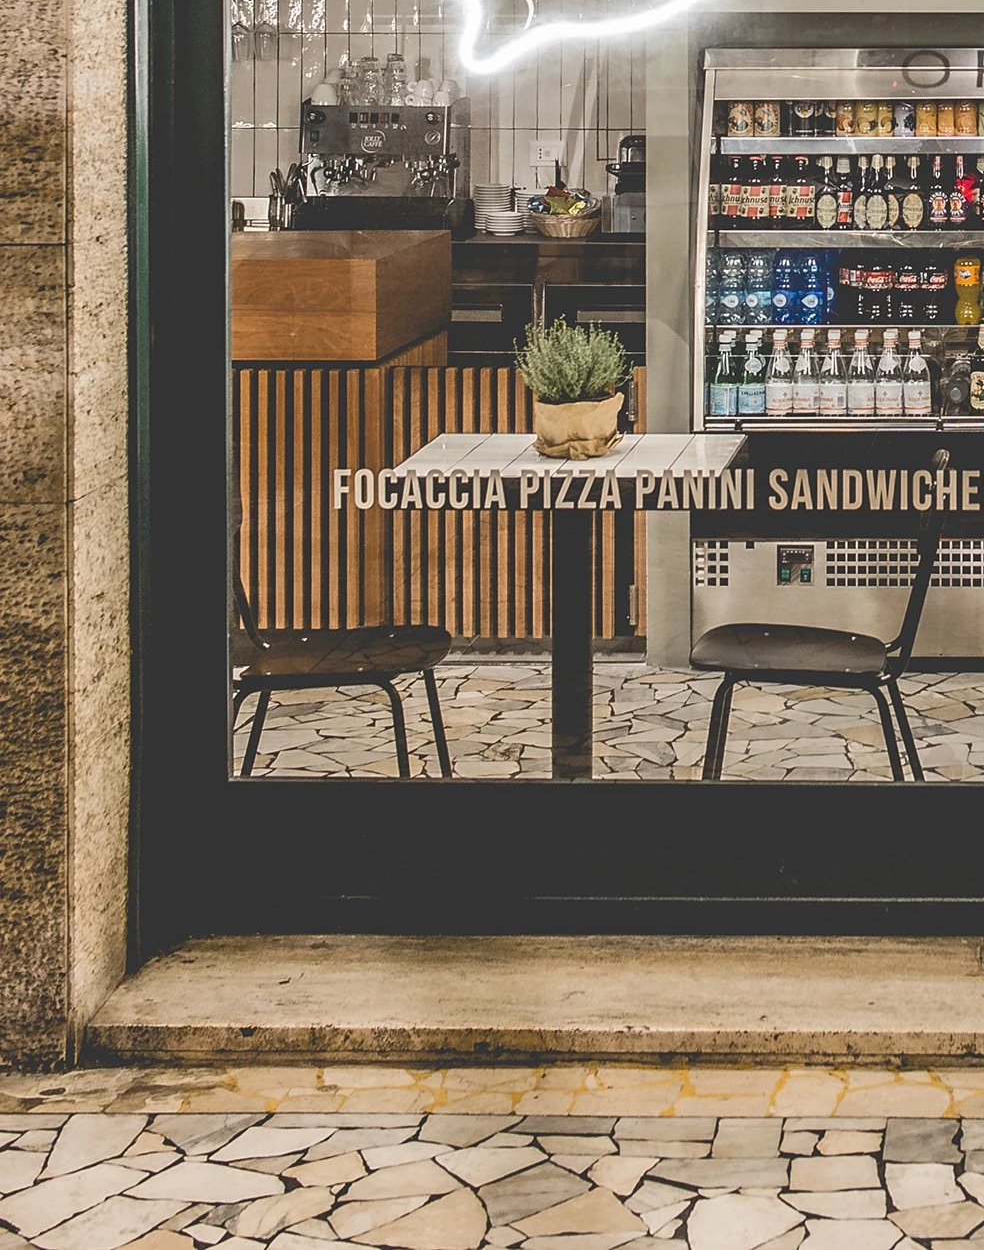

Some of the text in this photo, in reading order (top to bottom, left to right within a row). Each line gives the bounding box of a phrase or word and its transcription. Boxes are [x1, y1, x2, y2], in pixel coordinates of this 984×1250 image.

[333, 468, 507, 511] FOCACCIA
[519, 468, 622, 511] PIZZA
[635, 468, 756, 511] PANINI
